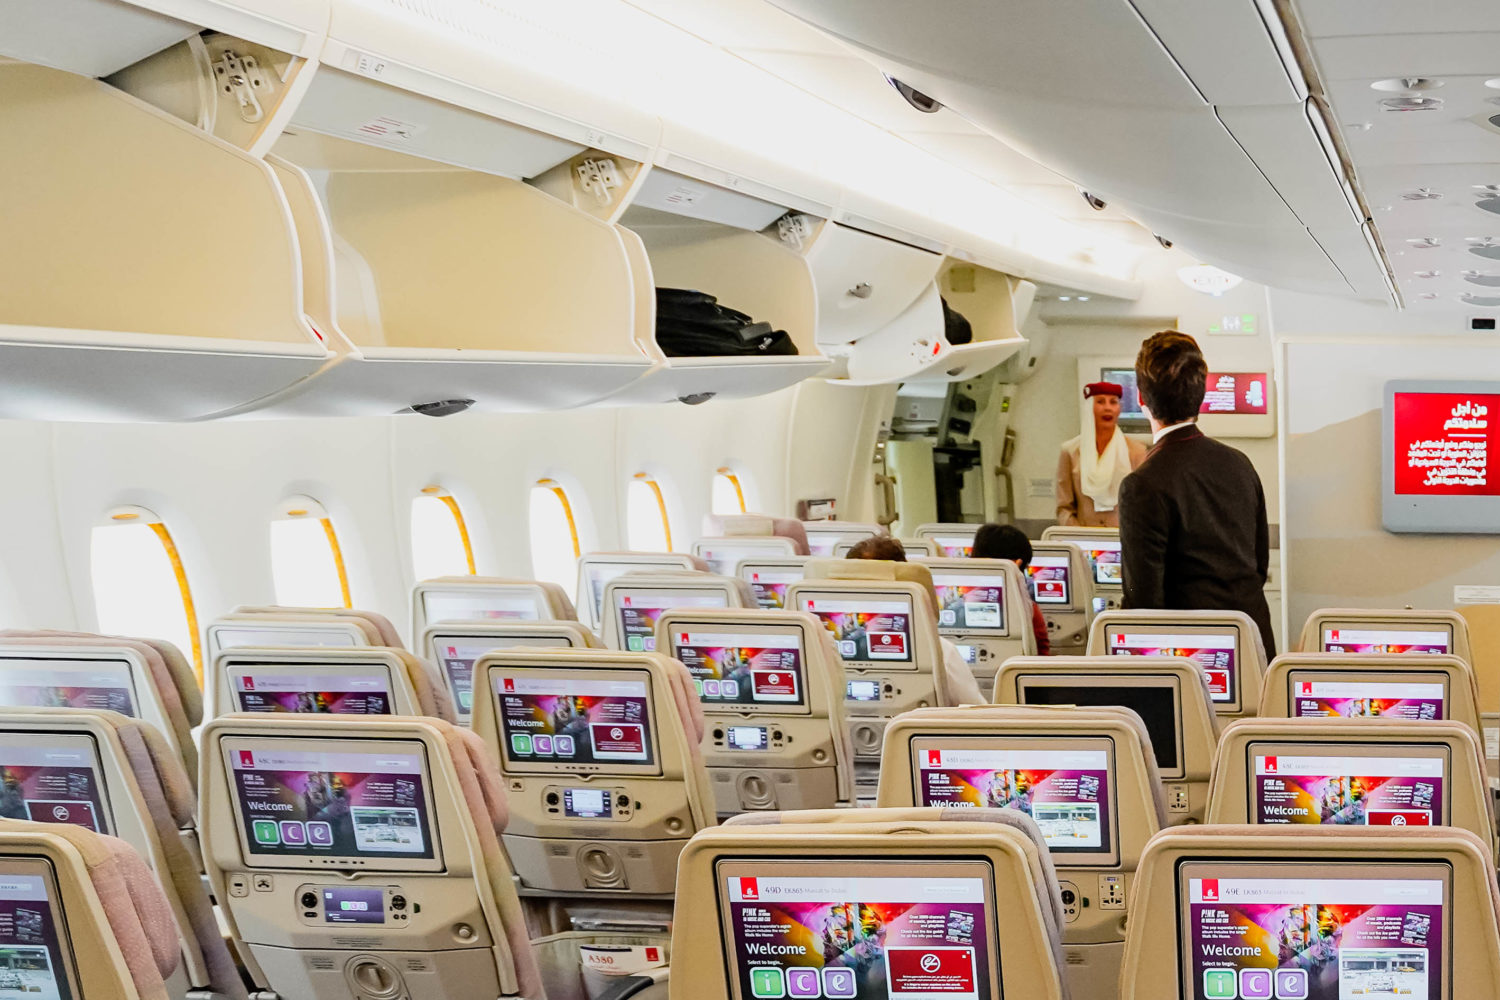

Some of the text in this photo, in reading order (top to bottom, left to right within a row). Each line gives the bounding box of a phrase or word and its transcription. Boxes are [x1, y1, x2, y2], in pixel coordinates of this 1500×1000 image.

[248, 801, 294, 812] Welcome
[1264, 806, 1309, 816] Welcome
[745, 943, 806, 955] Welcome
[1202, 944, 1261, 957] Welcome
[765, 973, 846, 992] i c e
[1217, 975, 1298, 993] i c e
